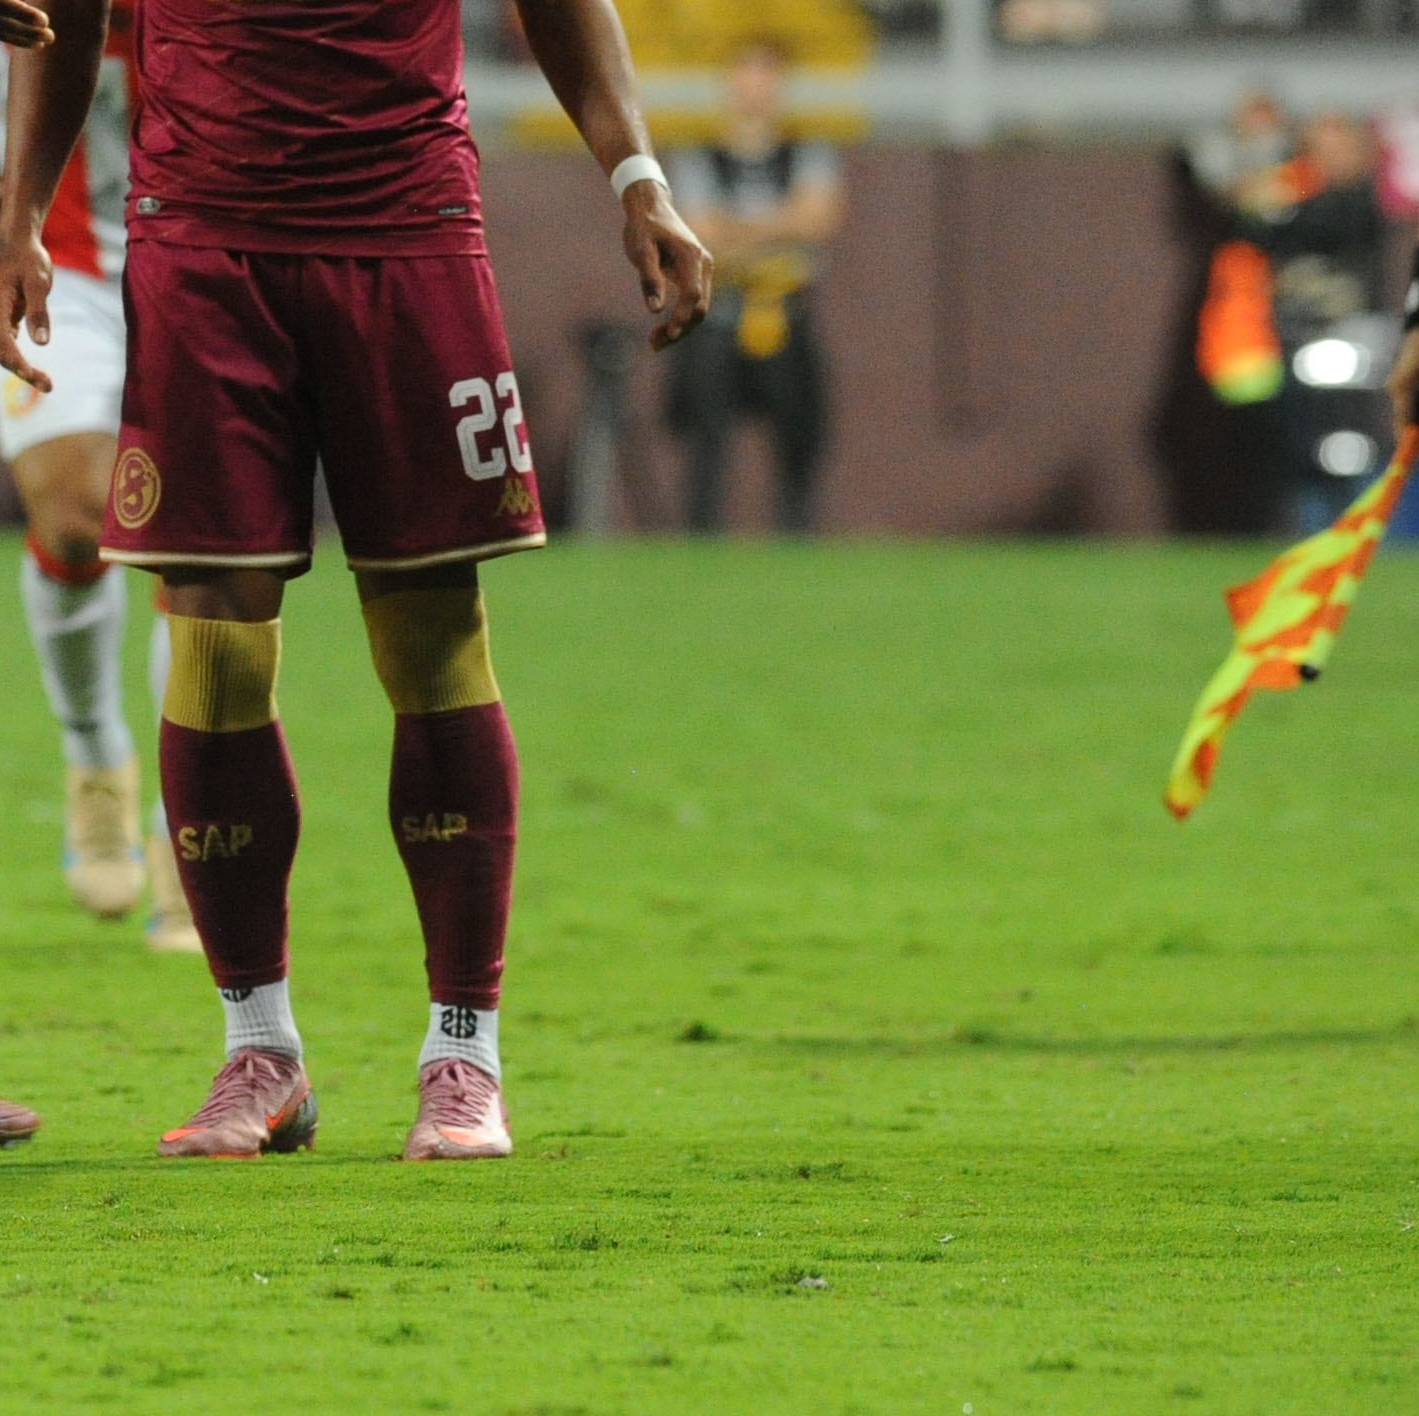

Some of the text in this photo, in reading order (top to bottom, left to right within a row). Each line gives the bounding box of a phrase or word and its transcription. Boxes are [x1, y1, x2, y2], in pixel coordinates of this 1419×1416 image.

[448, 371, 533, 481] 22
[177, 823, 253, 862] SAP
[401, 812, 468, 842] SAP
